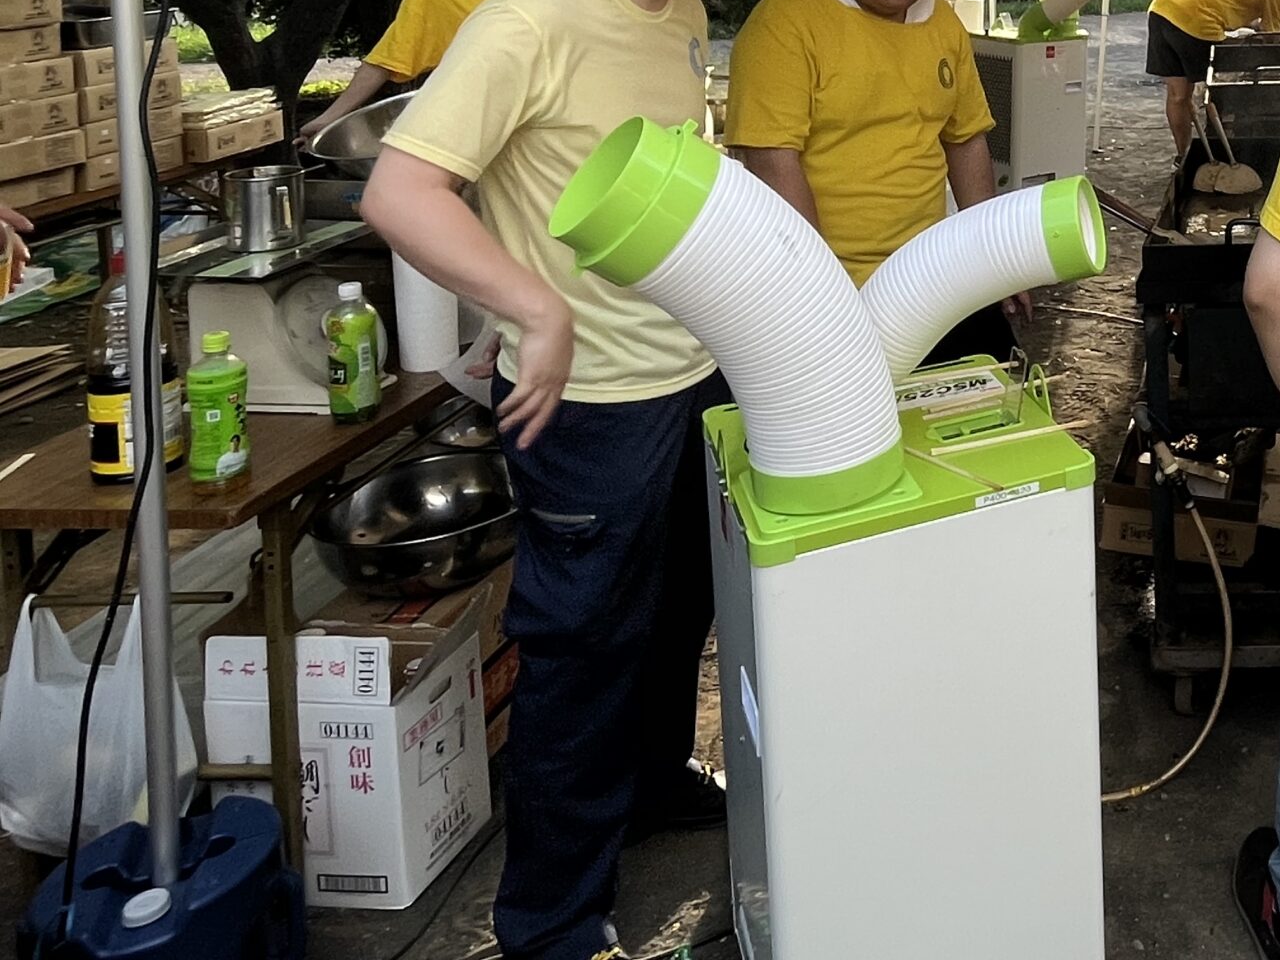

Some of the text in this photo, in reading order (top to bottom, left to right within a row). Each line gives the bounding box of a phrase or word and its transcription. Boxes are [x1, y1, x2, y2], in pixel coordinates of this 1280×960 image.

[356, 649, 376, 694] 04144
[323, 724, 369, 739] 04144
[349, 745, 375, 795] 創味
